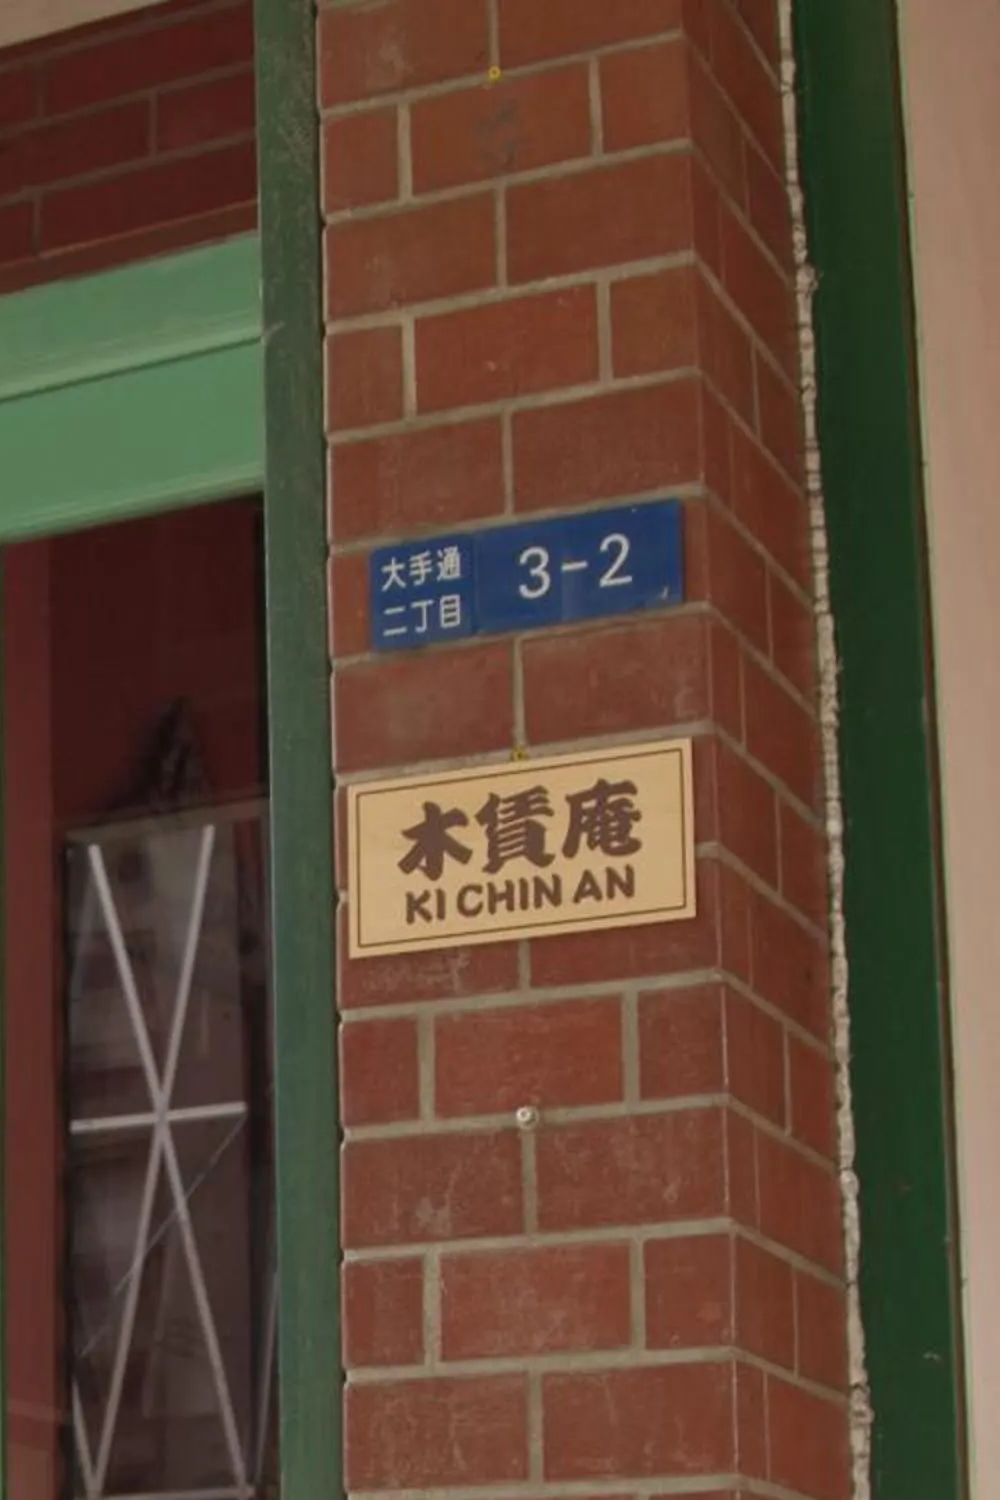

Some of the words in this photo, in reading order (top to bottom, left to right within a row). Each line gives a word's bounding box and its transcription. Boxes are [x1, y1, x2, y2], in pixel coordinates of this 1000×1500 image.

[381, 545, 462, 591] 大手通
[518, 532, 633, 599] 3-2
[382, 593, 461, 637] 二丁目
[397, 778, 643, 882] 木賃庵
